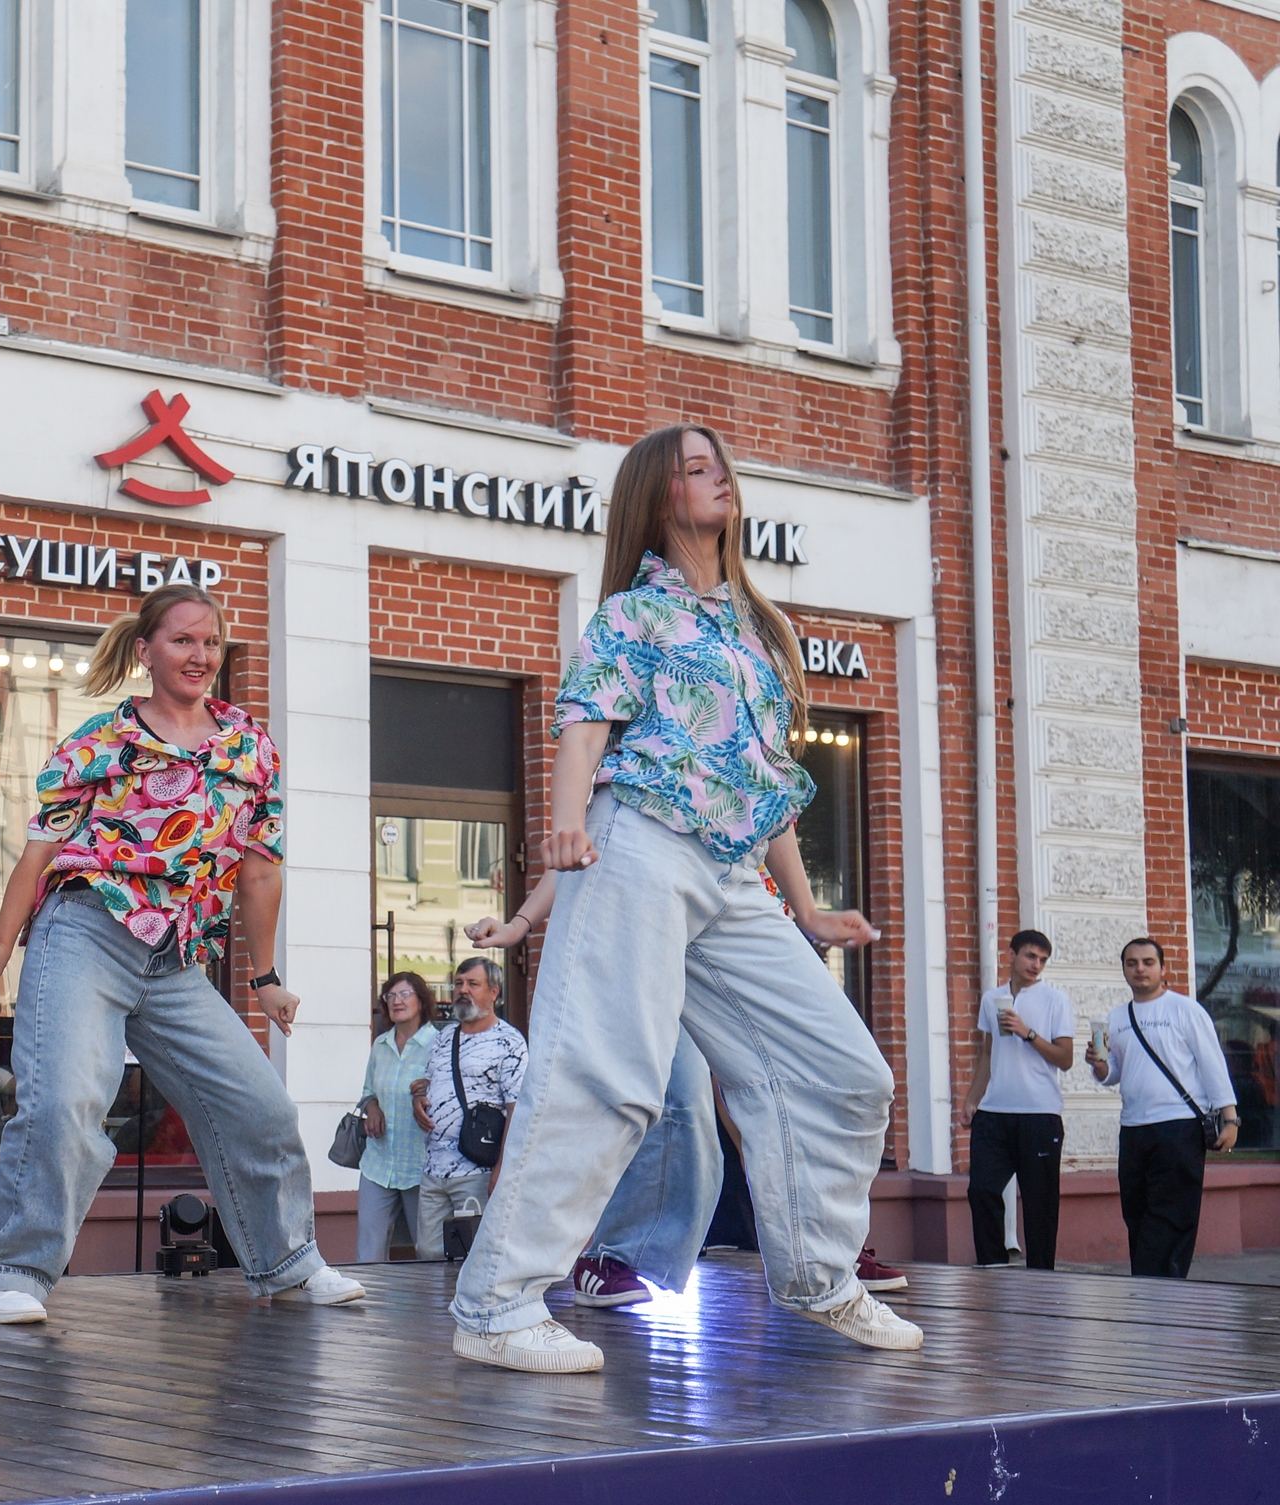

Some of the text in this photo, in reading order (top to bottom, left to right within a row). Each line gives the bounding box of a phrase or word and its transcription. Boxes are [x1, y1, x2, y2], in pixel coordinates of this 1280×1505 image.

[287, 443, 602, 534] ЯПОНСКИЙ
[743, 517, 809, 566] ИК
[800, 636, 869, 680] ВКА
